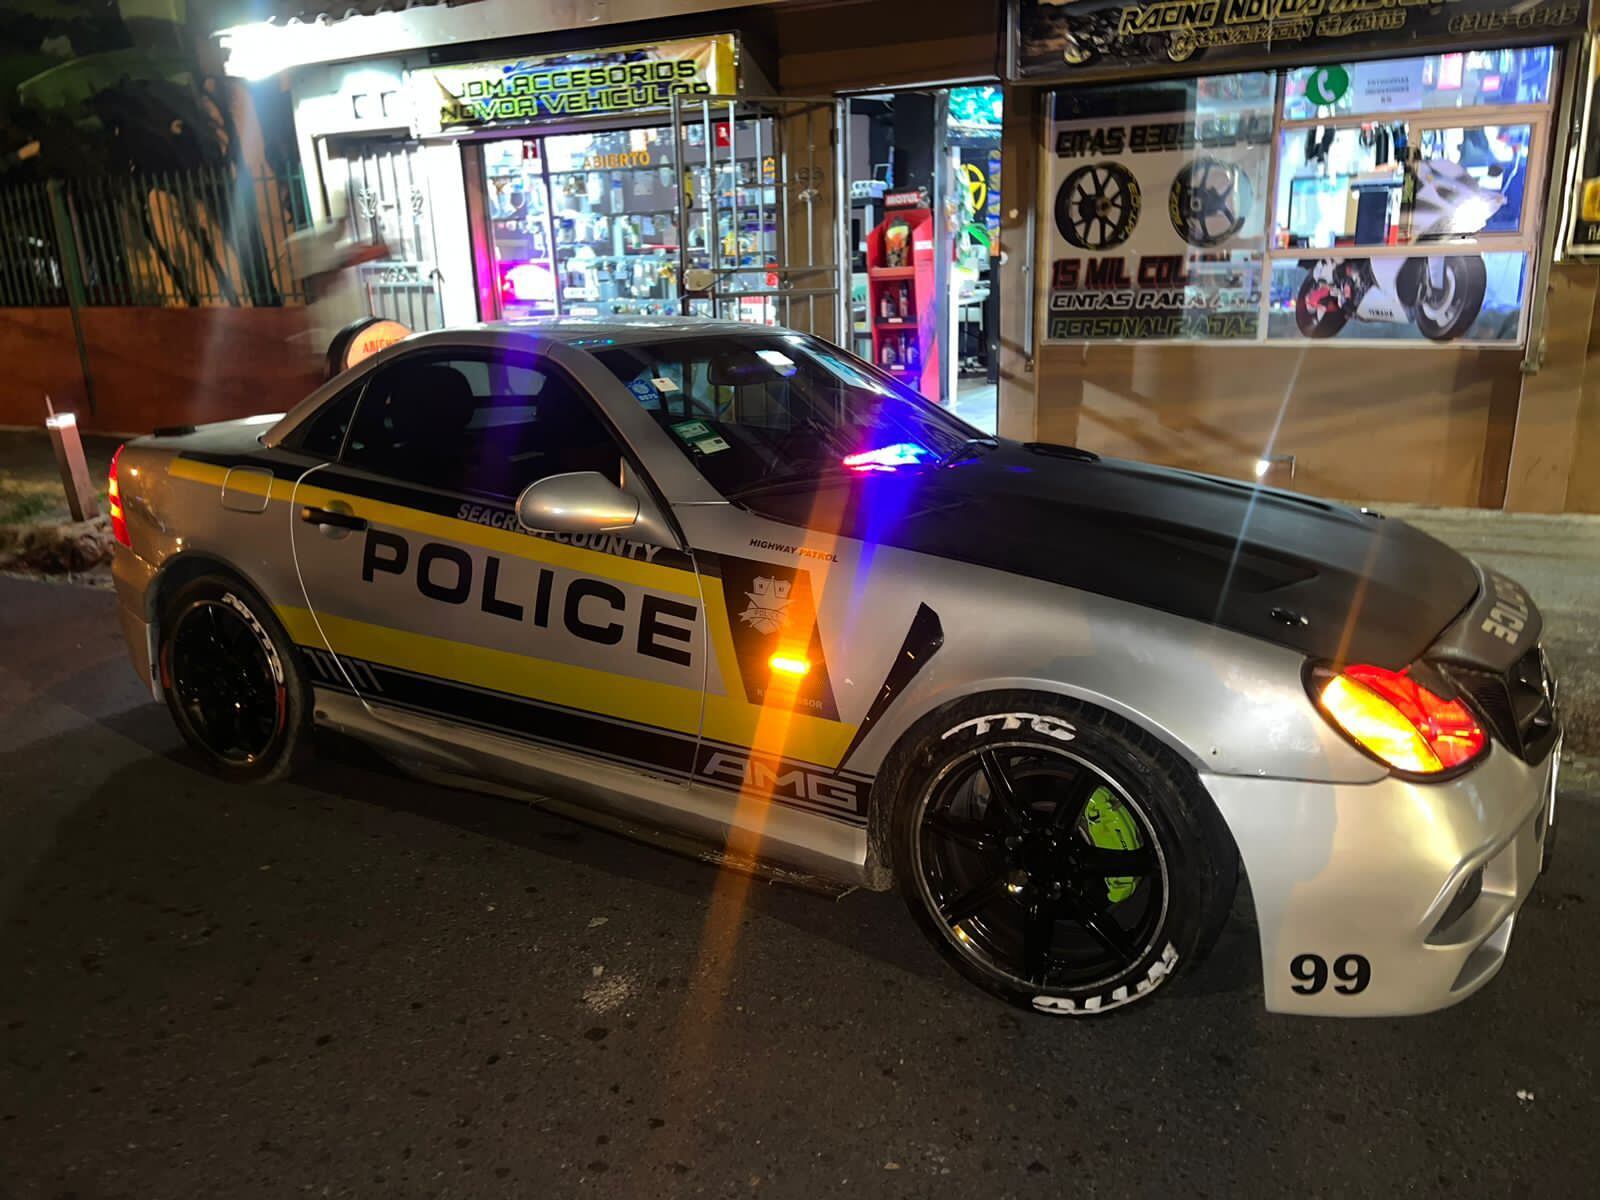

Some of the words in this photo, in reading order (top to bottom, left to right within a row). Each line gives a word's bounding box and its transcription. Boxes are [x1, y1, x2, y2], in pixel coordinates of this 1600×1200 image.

[1119, 0, 1219, 36] RACING
[514, 60, 696, 91] ACCESORIOS
[583, 151, 650, 169] ABIERTO
[1052, 258, 1081, 289] 15
[1085, 256, 1132, 289] MIL
[1051, 290, 1133, 310] CINTAS
[749, 538, 797, 555] HIGHWAY
[798, 547, 839, 563] PATROL
[362, 528, 698, 667] POLICE
[703, 751, 858, 812] AMG
[1289, 952, 1372, 996] 99
